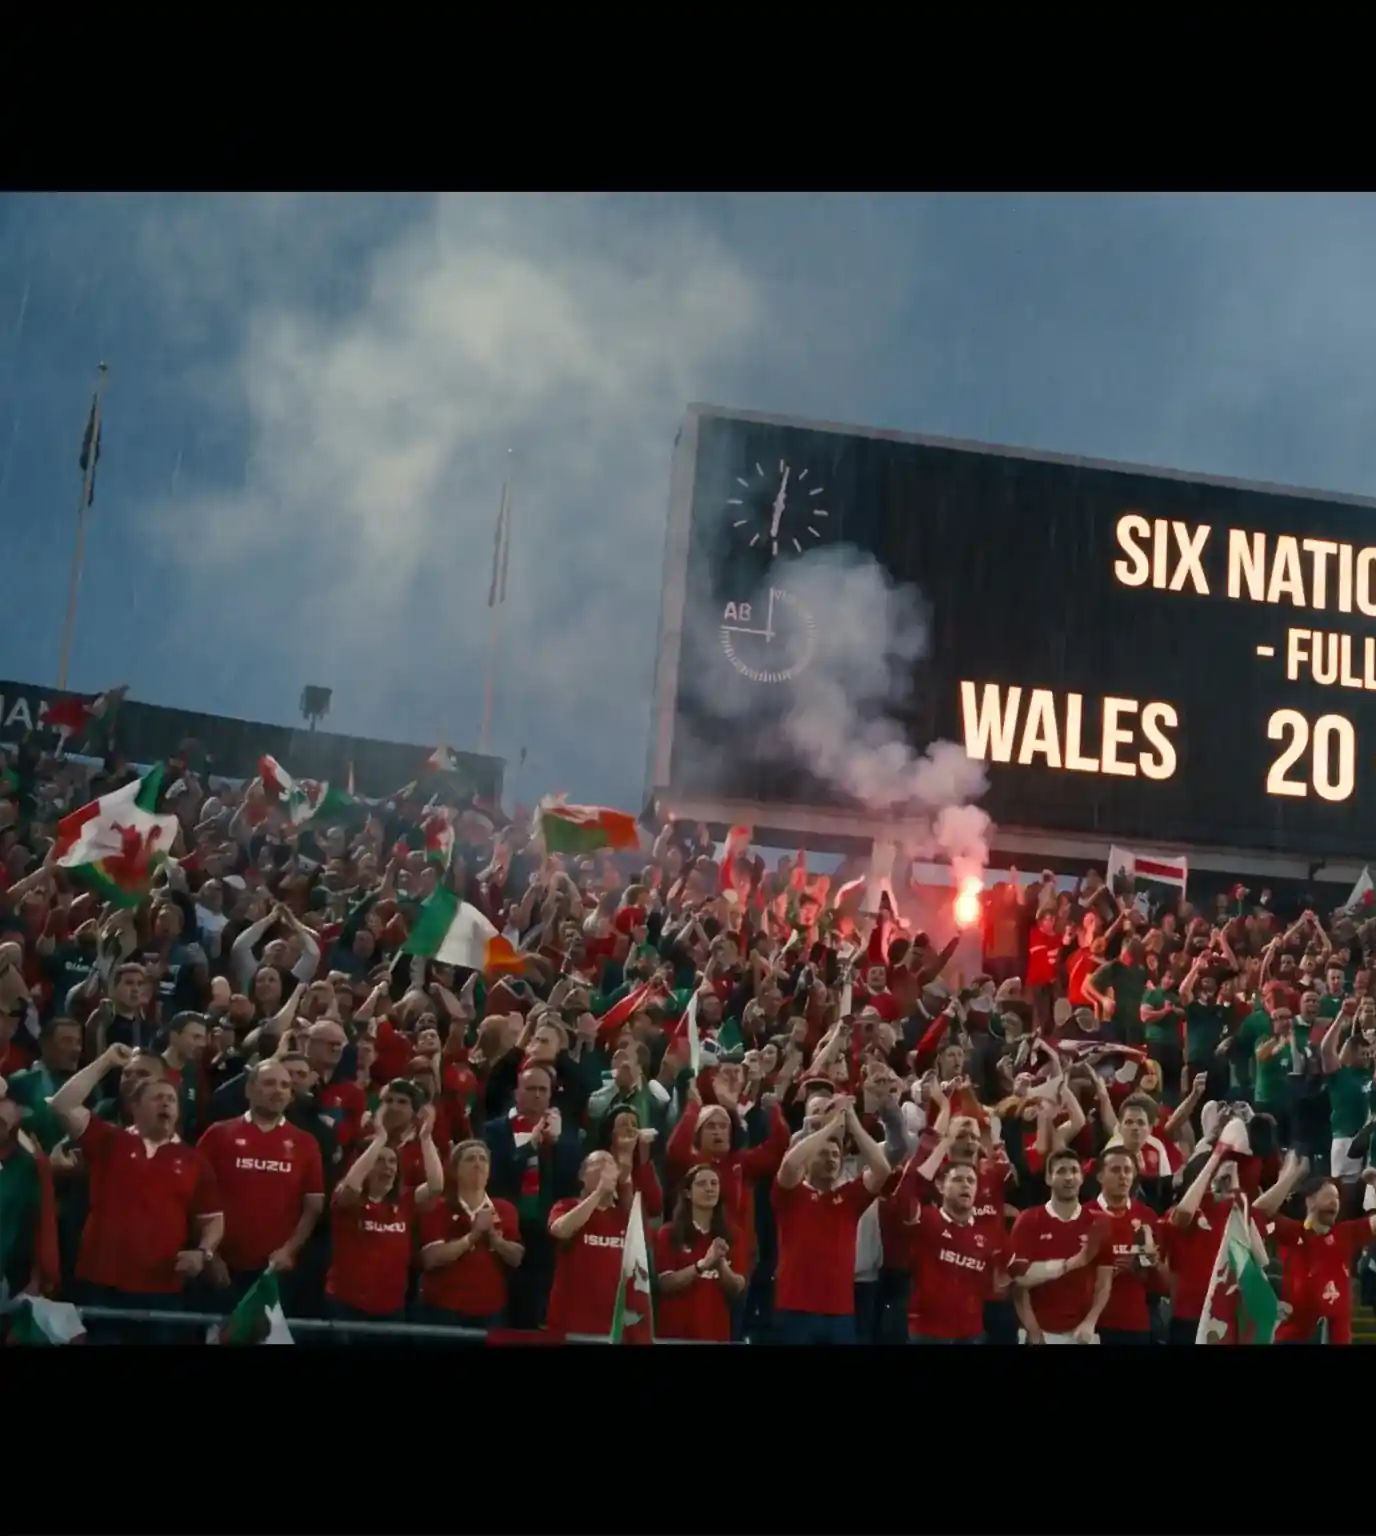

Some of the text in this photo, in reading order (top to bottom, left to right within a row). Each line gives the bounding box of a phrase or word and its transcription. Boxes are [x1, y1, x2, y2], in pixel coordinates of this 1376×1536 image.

[1114, 514, 1212, 595] SIX
[959, 680, 1178, 780] WALES
[1266, 708, 1355, 802] 20
[235, 1156, 292, 1173] ISUZU
[939, 1248, 987, 1272] ISUZU
